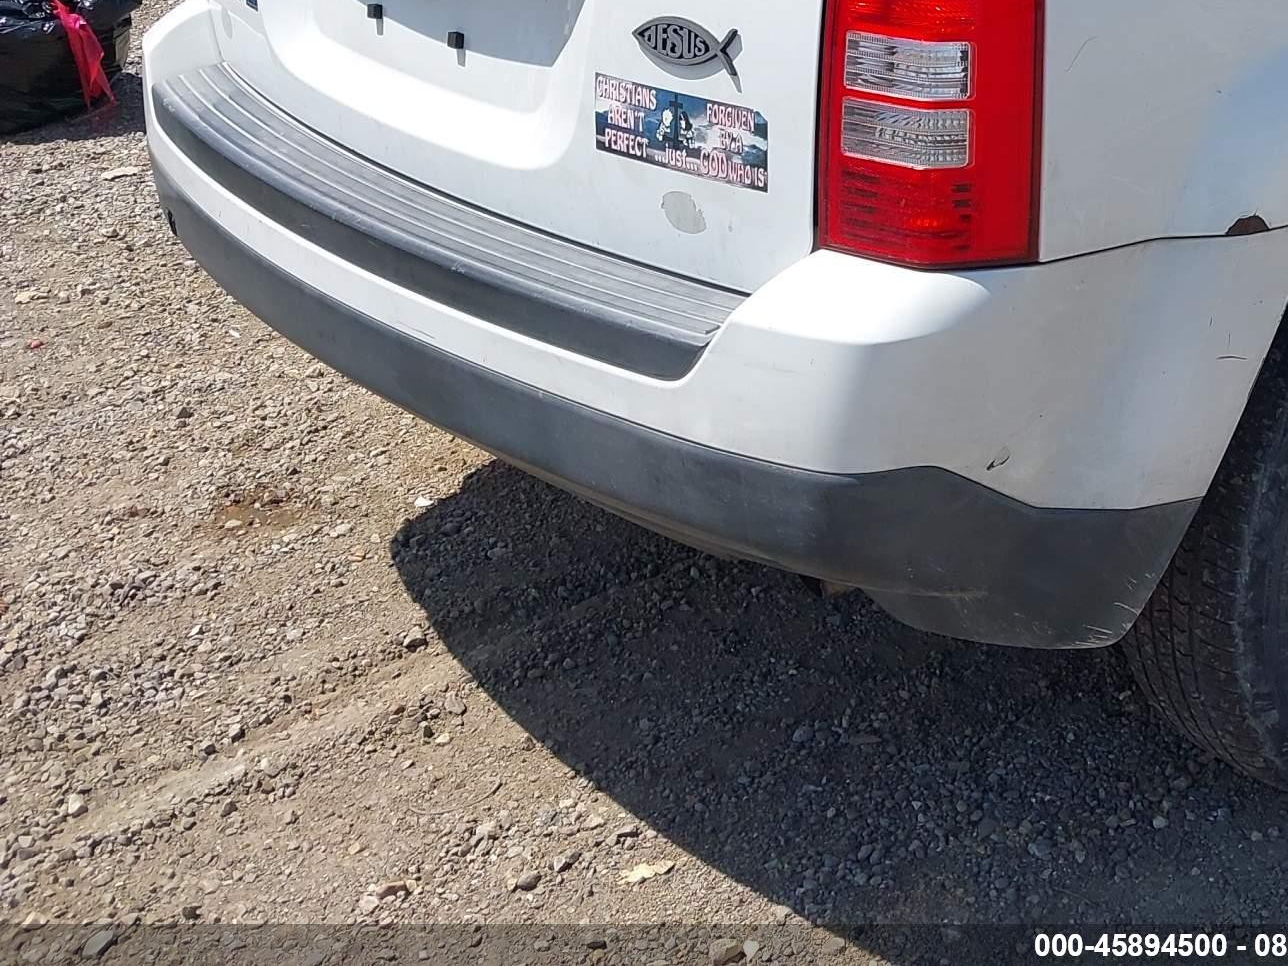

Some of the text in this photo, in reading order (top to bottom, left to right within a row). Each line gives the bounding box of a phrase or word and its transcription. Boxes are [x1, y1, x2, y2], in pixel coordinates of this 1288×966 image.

[644, 24, 706, 59] JESUS
[596, 76, 657, 111] CHRISTIANS
[607, 101, 645, 133] AREN'T
[706, 103, 755, 133] FORGIVEN
[605, 128, 649, 158] PERFECT
[700, 149, 728, 179] GOD
[728, 160, 752, 185] WHO
